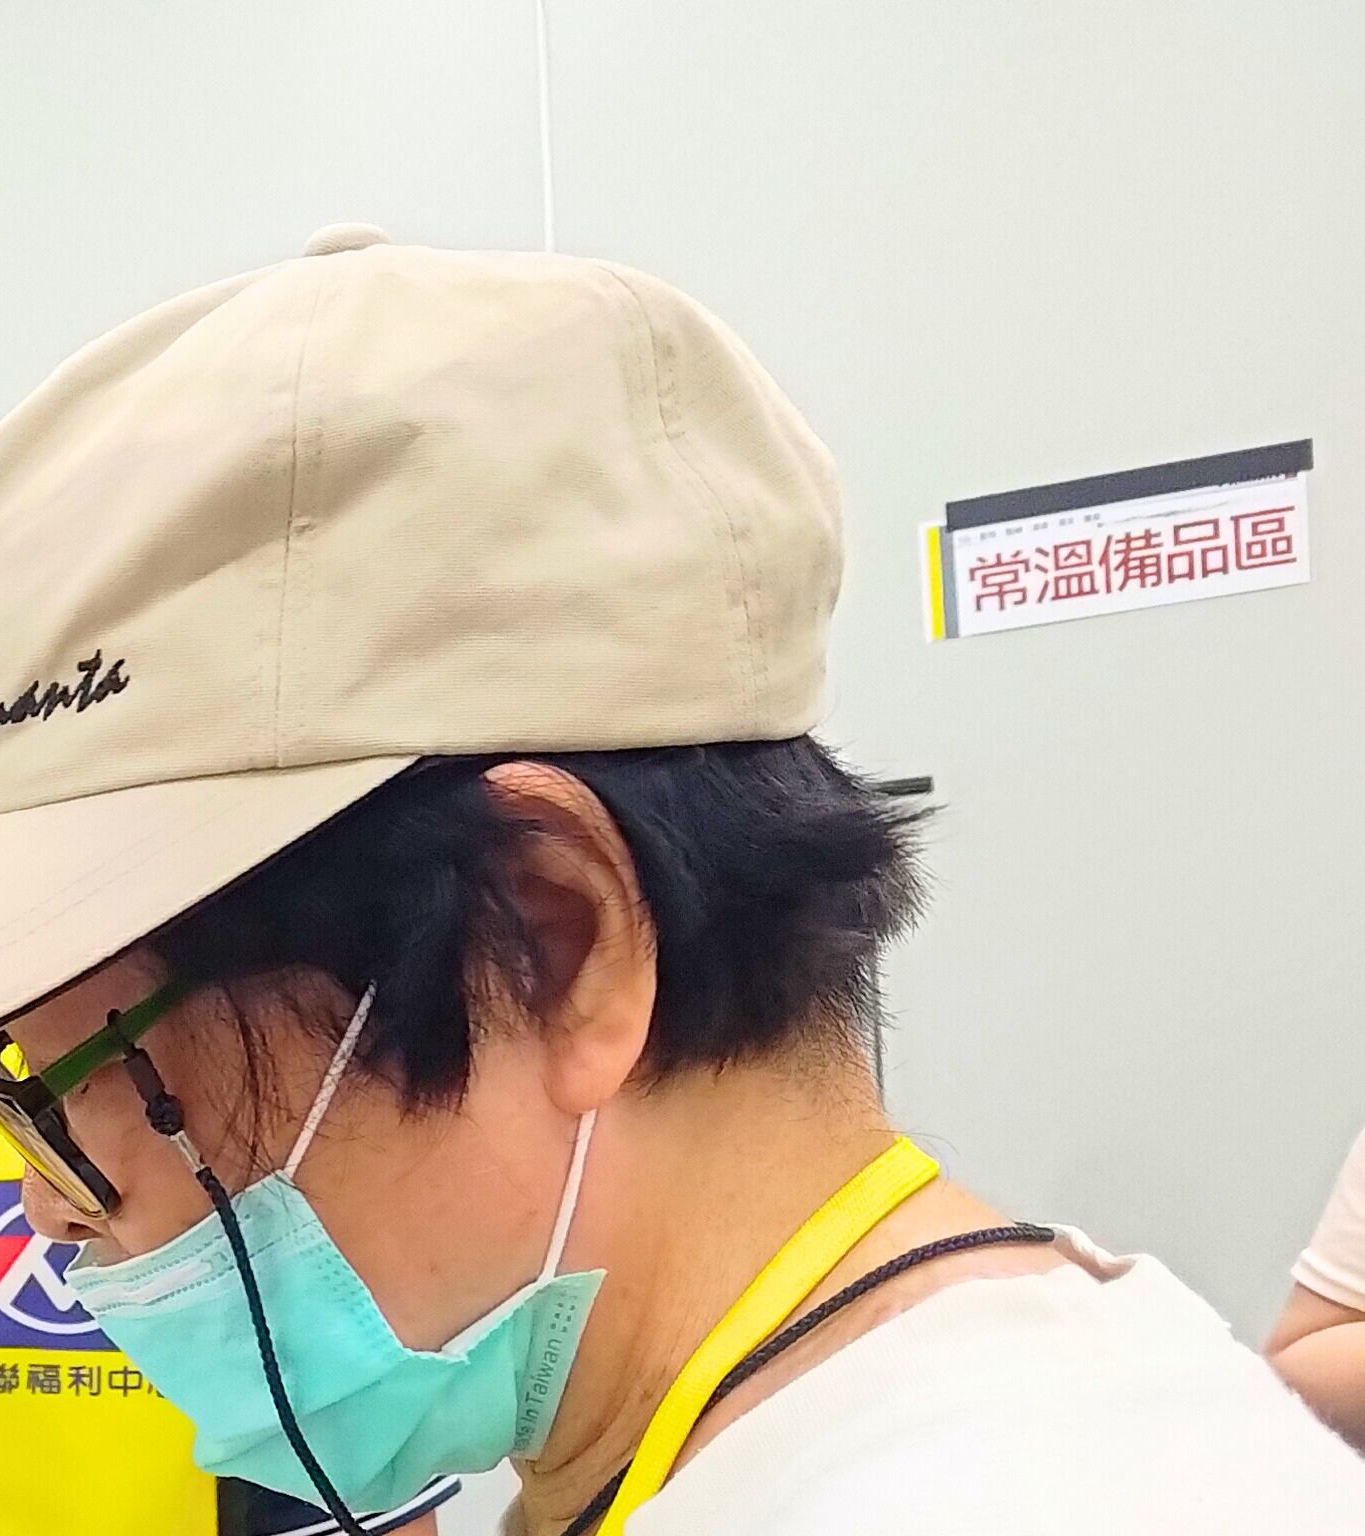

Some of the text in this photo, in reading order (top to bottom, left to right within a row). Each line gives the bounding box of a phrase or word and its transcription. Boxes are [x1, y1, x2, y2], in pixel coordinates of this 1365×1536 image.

[969, 505, 1298, 614] 常溫備品區
[525, 1338, 563, 1404] Taiwan
